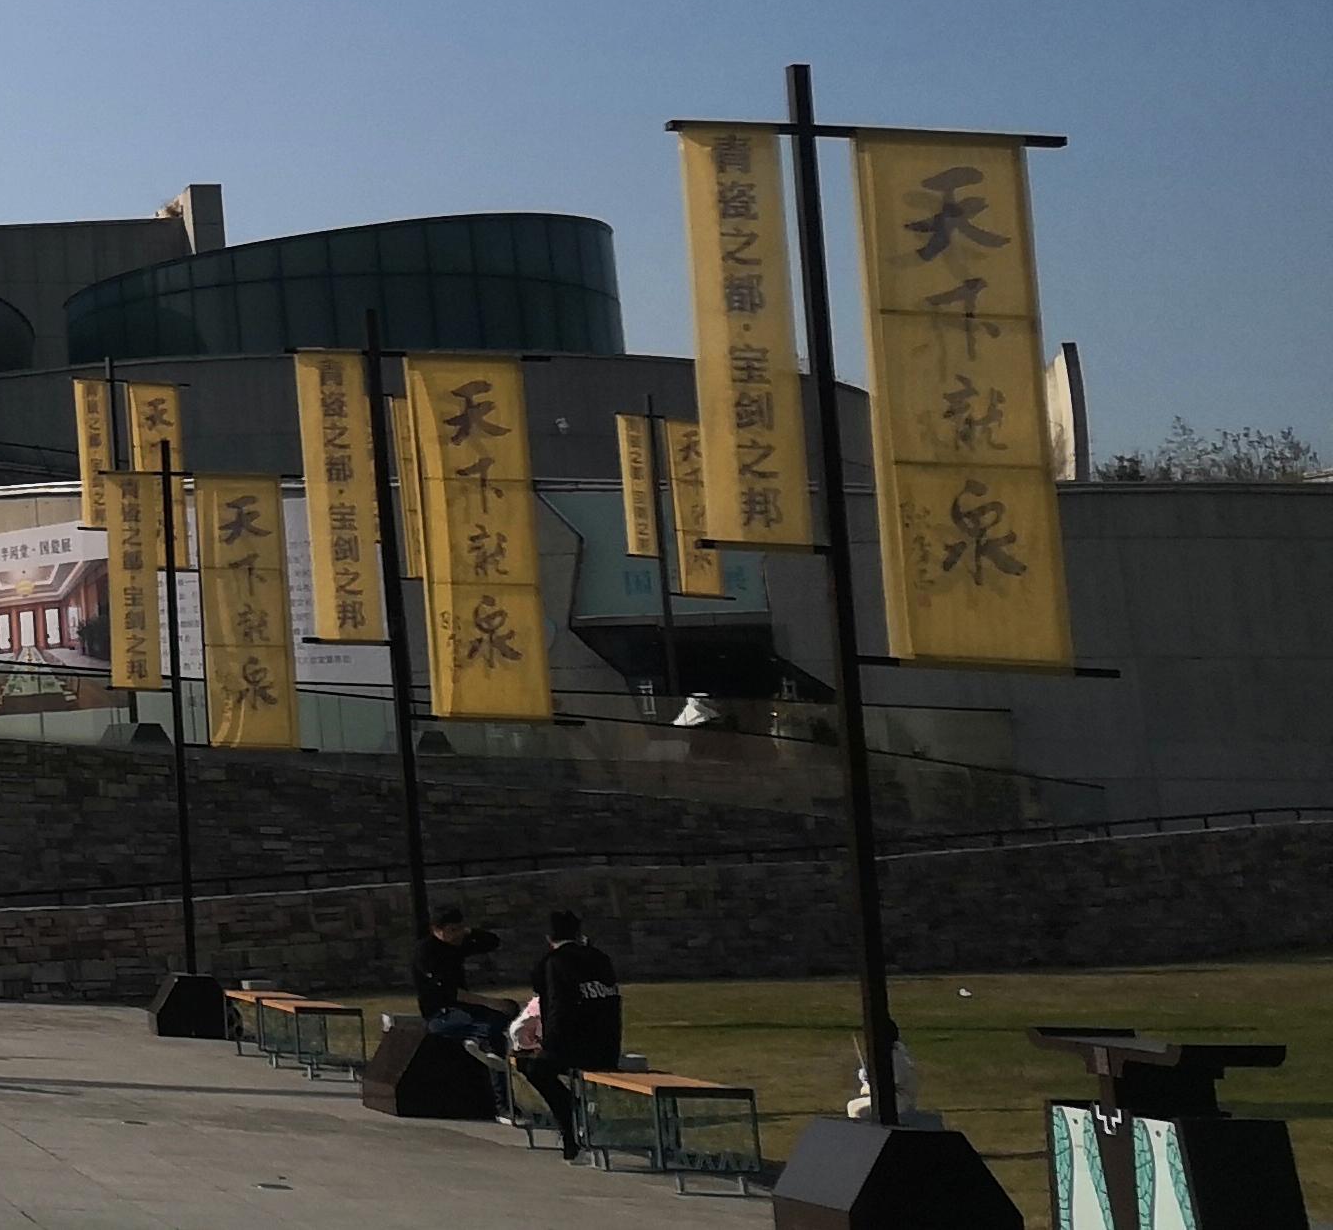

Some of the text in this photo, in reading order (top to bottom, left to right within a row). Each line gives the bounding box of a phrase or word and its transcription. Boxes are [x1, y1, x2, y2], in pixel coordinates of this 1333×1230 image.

[444, 379, 524, 670] 天下龍泉
[905, 165, 1027, 586] 天下龍泉
